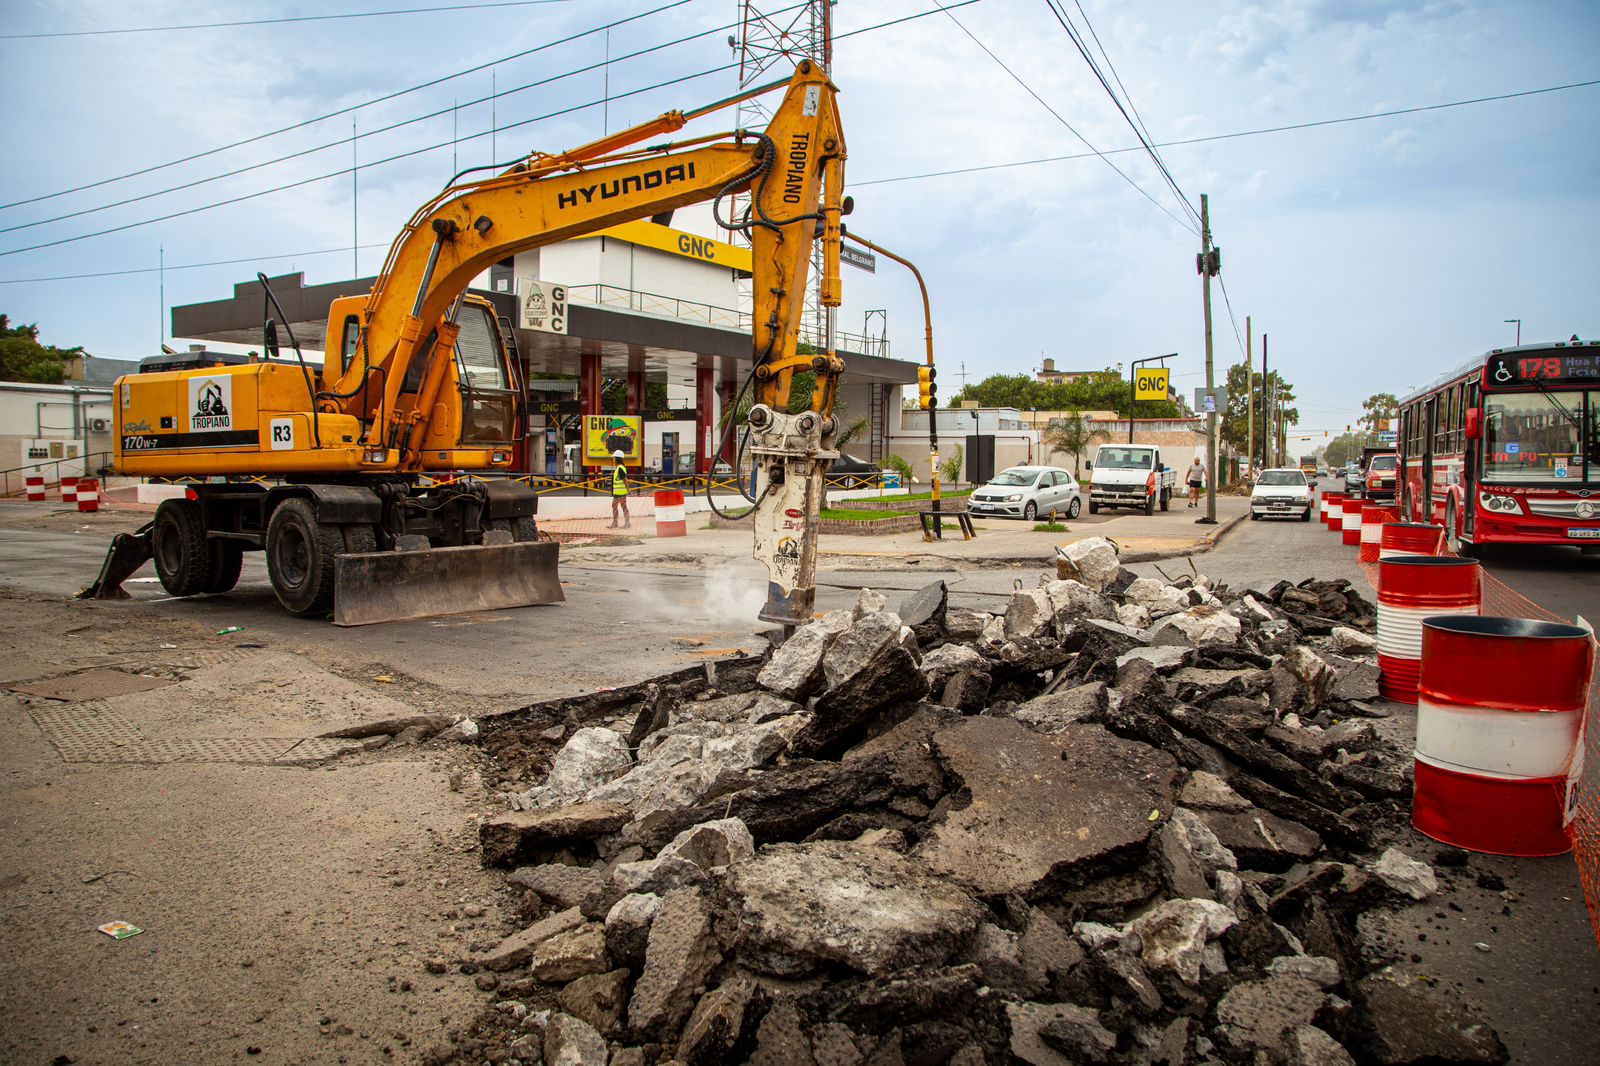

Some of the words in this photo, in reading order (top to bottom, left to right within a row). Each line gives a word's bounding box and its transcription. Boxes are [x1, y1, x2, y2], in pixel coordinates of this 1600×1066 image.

[783, 132, 810, 204] TROPIANO
[558, 162, 696, 209] HYUNDAI
[678, 234, 715, 259] GNC
[551, 287, 565, 331] GNC
[1520, 357, 1561, 378] 178
[1138, 376, 1165, 391] GNC
[540, 403, 559, 412] GNC
[657, 410, 675, 419] GNC
[191, 416, 231, 429] TROPIANO
[273, 425, 291, 442] R3
